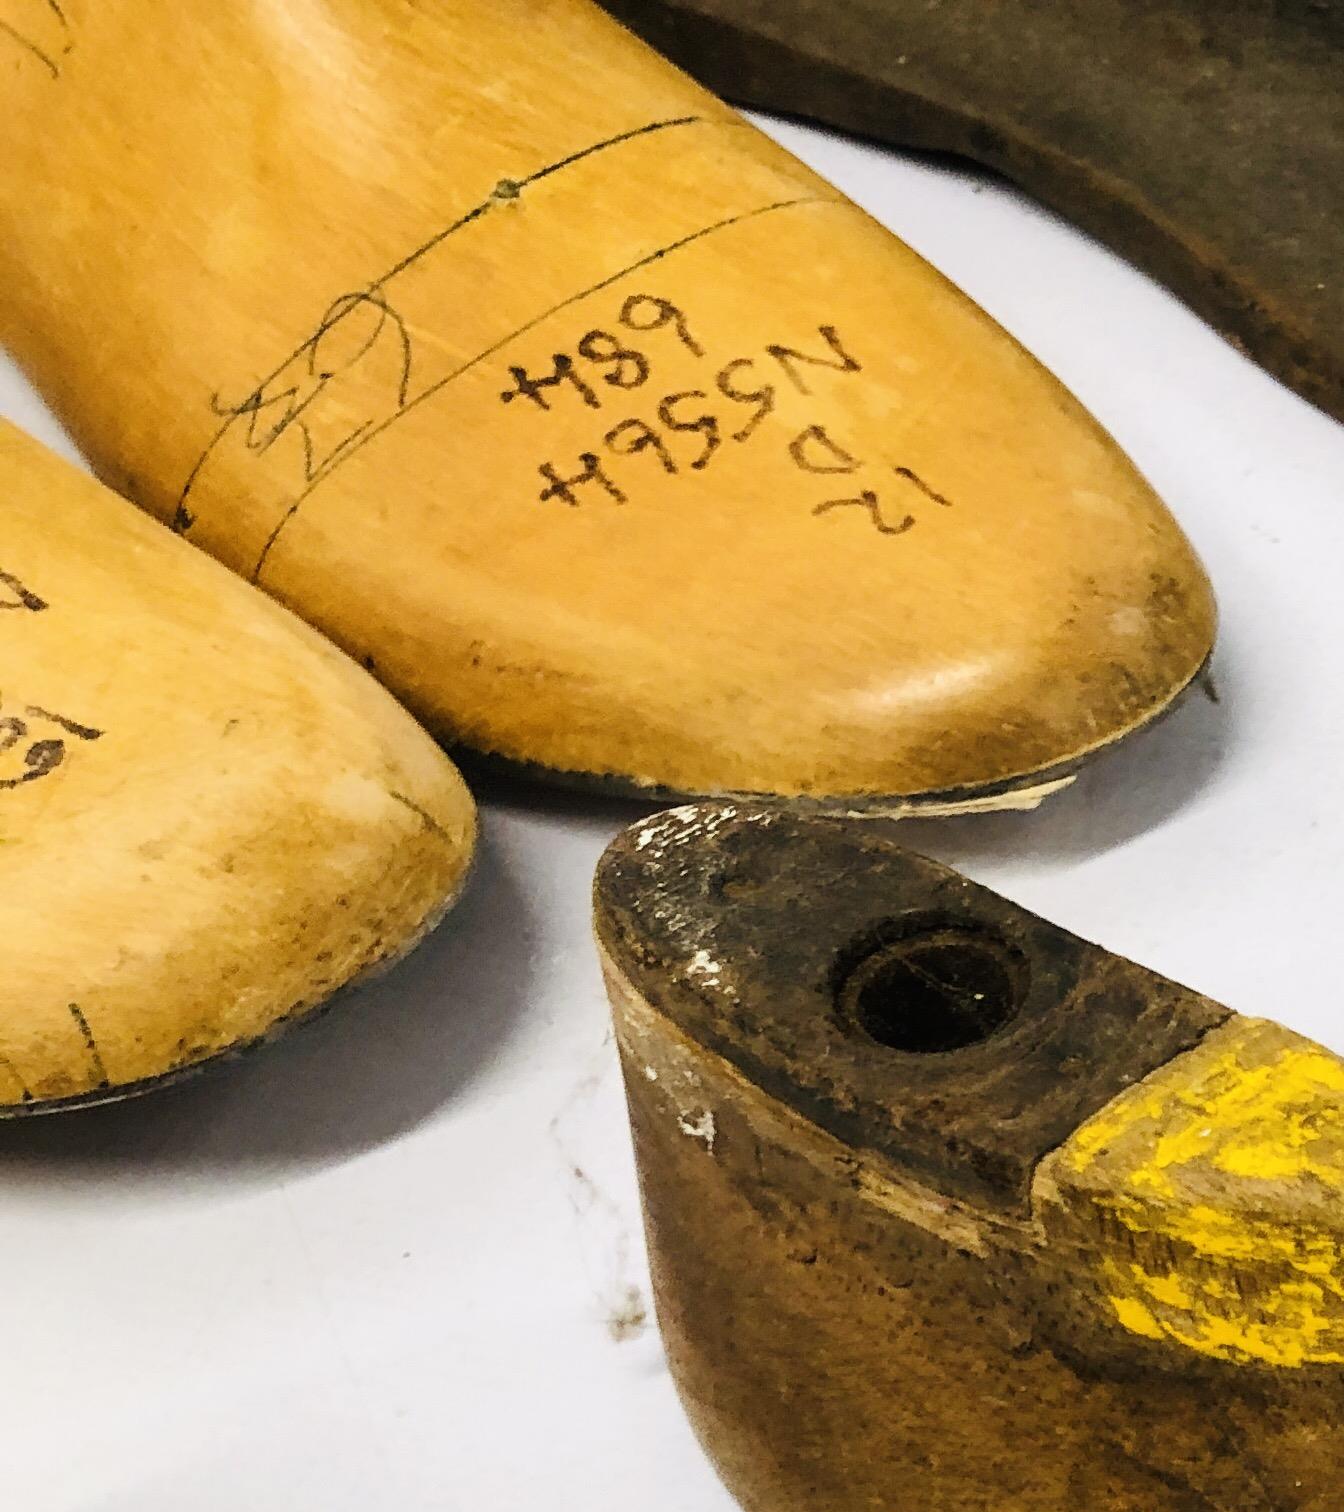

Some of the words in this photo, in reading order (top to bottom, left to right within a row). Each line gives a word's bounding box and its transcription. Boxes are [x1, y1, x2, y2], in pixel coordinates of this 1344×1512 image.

[498, 290, 706, 412] 684
[536, 322, 865, 508] N5564
[788, 422, 860, 476] D
[808, 462, 954, 536] 12
